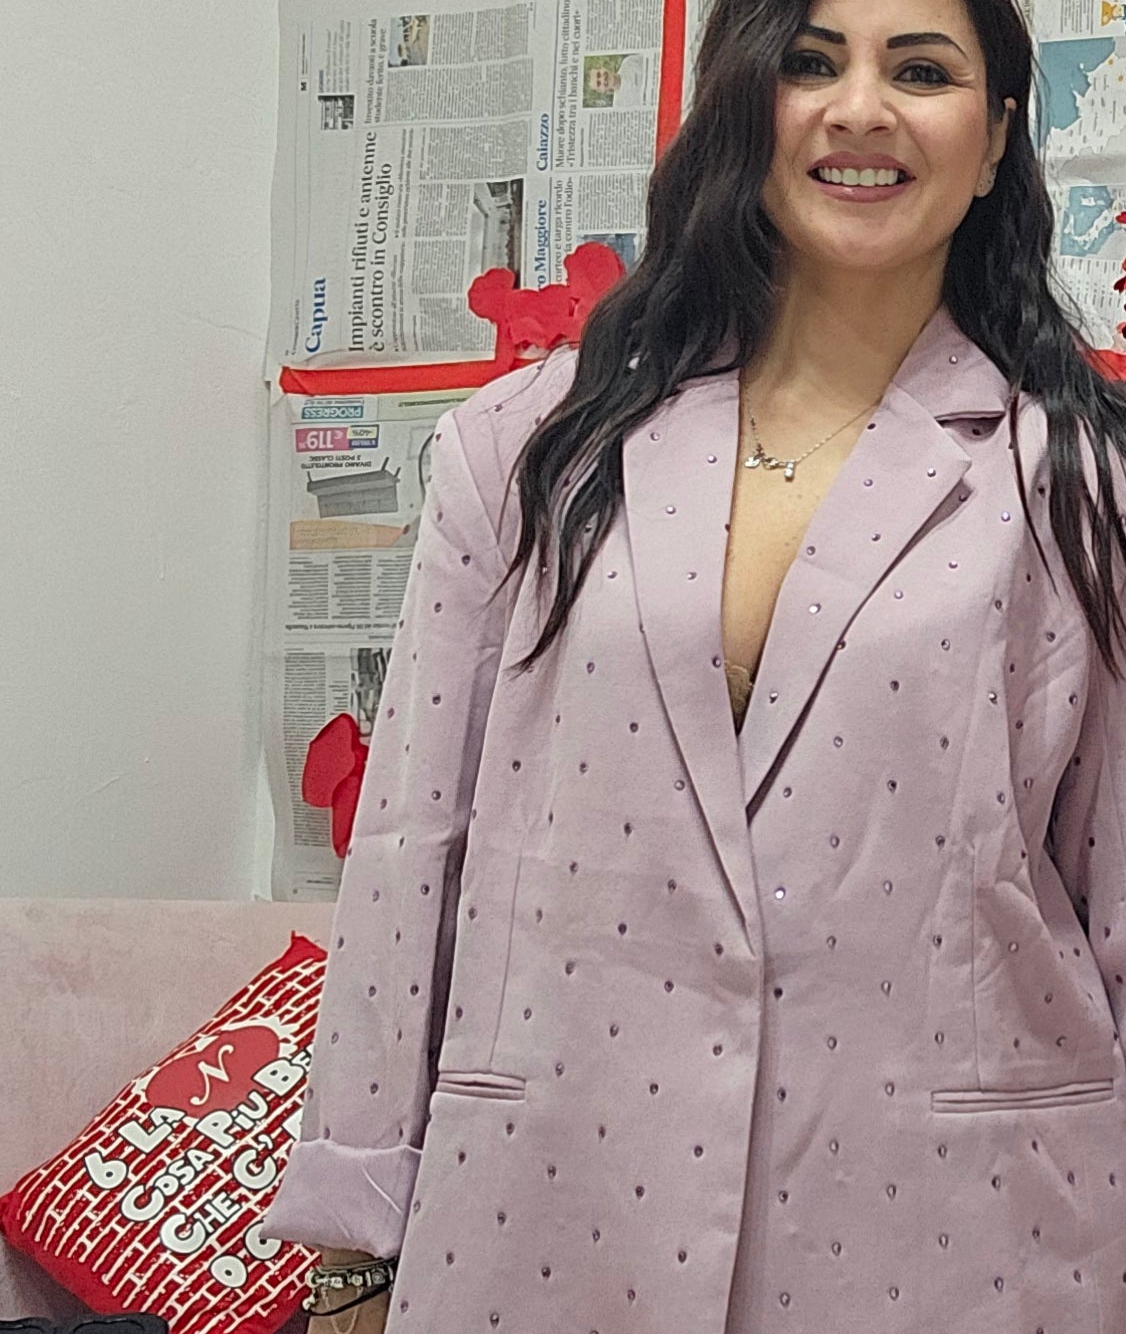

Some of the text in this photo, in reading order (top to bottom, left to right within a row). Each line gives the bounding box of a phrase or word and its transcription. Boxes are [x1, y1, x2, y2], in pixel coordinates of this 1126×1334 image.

[536, 114, 550, 172] Caiazzo
[372, 163, 395, 248] Consiglio
[348, 131, 377, 352] Impianti rifiuti e antenne
[371, 249, 385, 265] in
[305, 278, 328, 353] Capua
[371, 270, 385, 338] scontro
[304, 407, 361, 418] PROGRESS
[84, 1150, 128, 1189] 6
